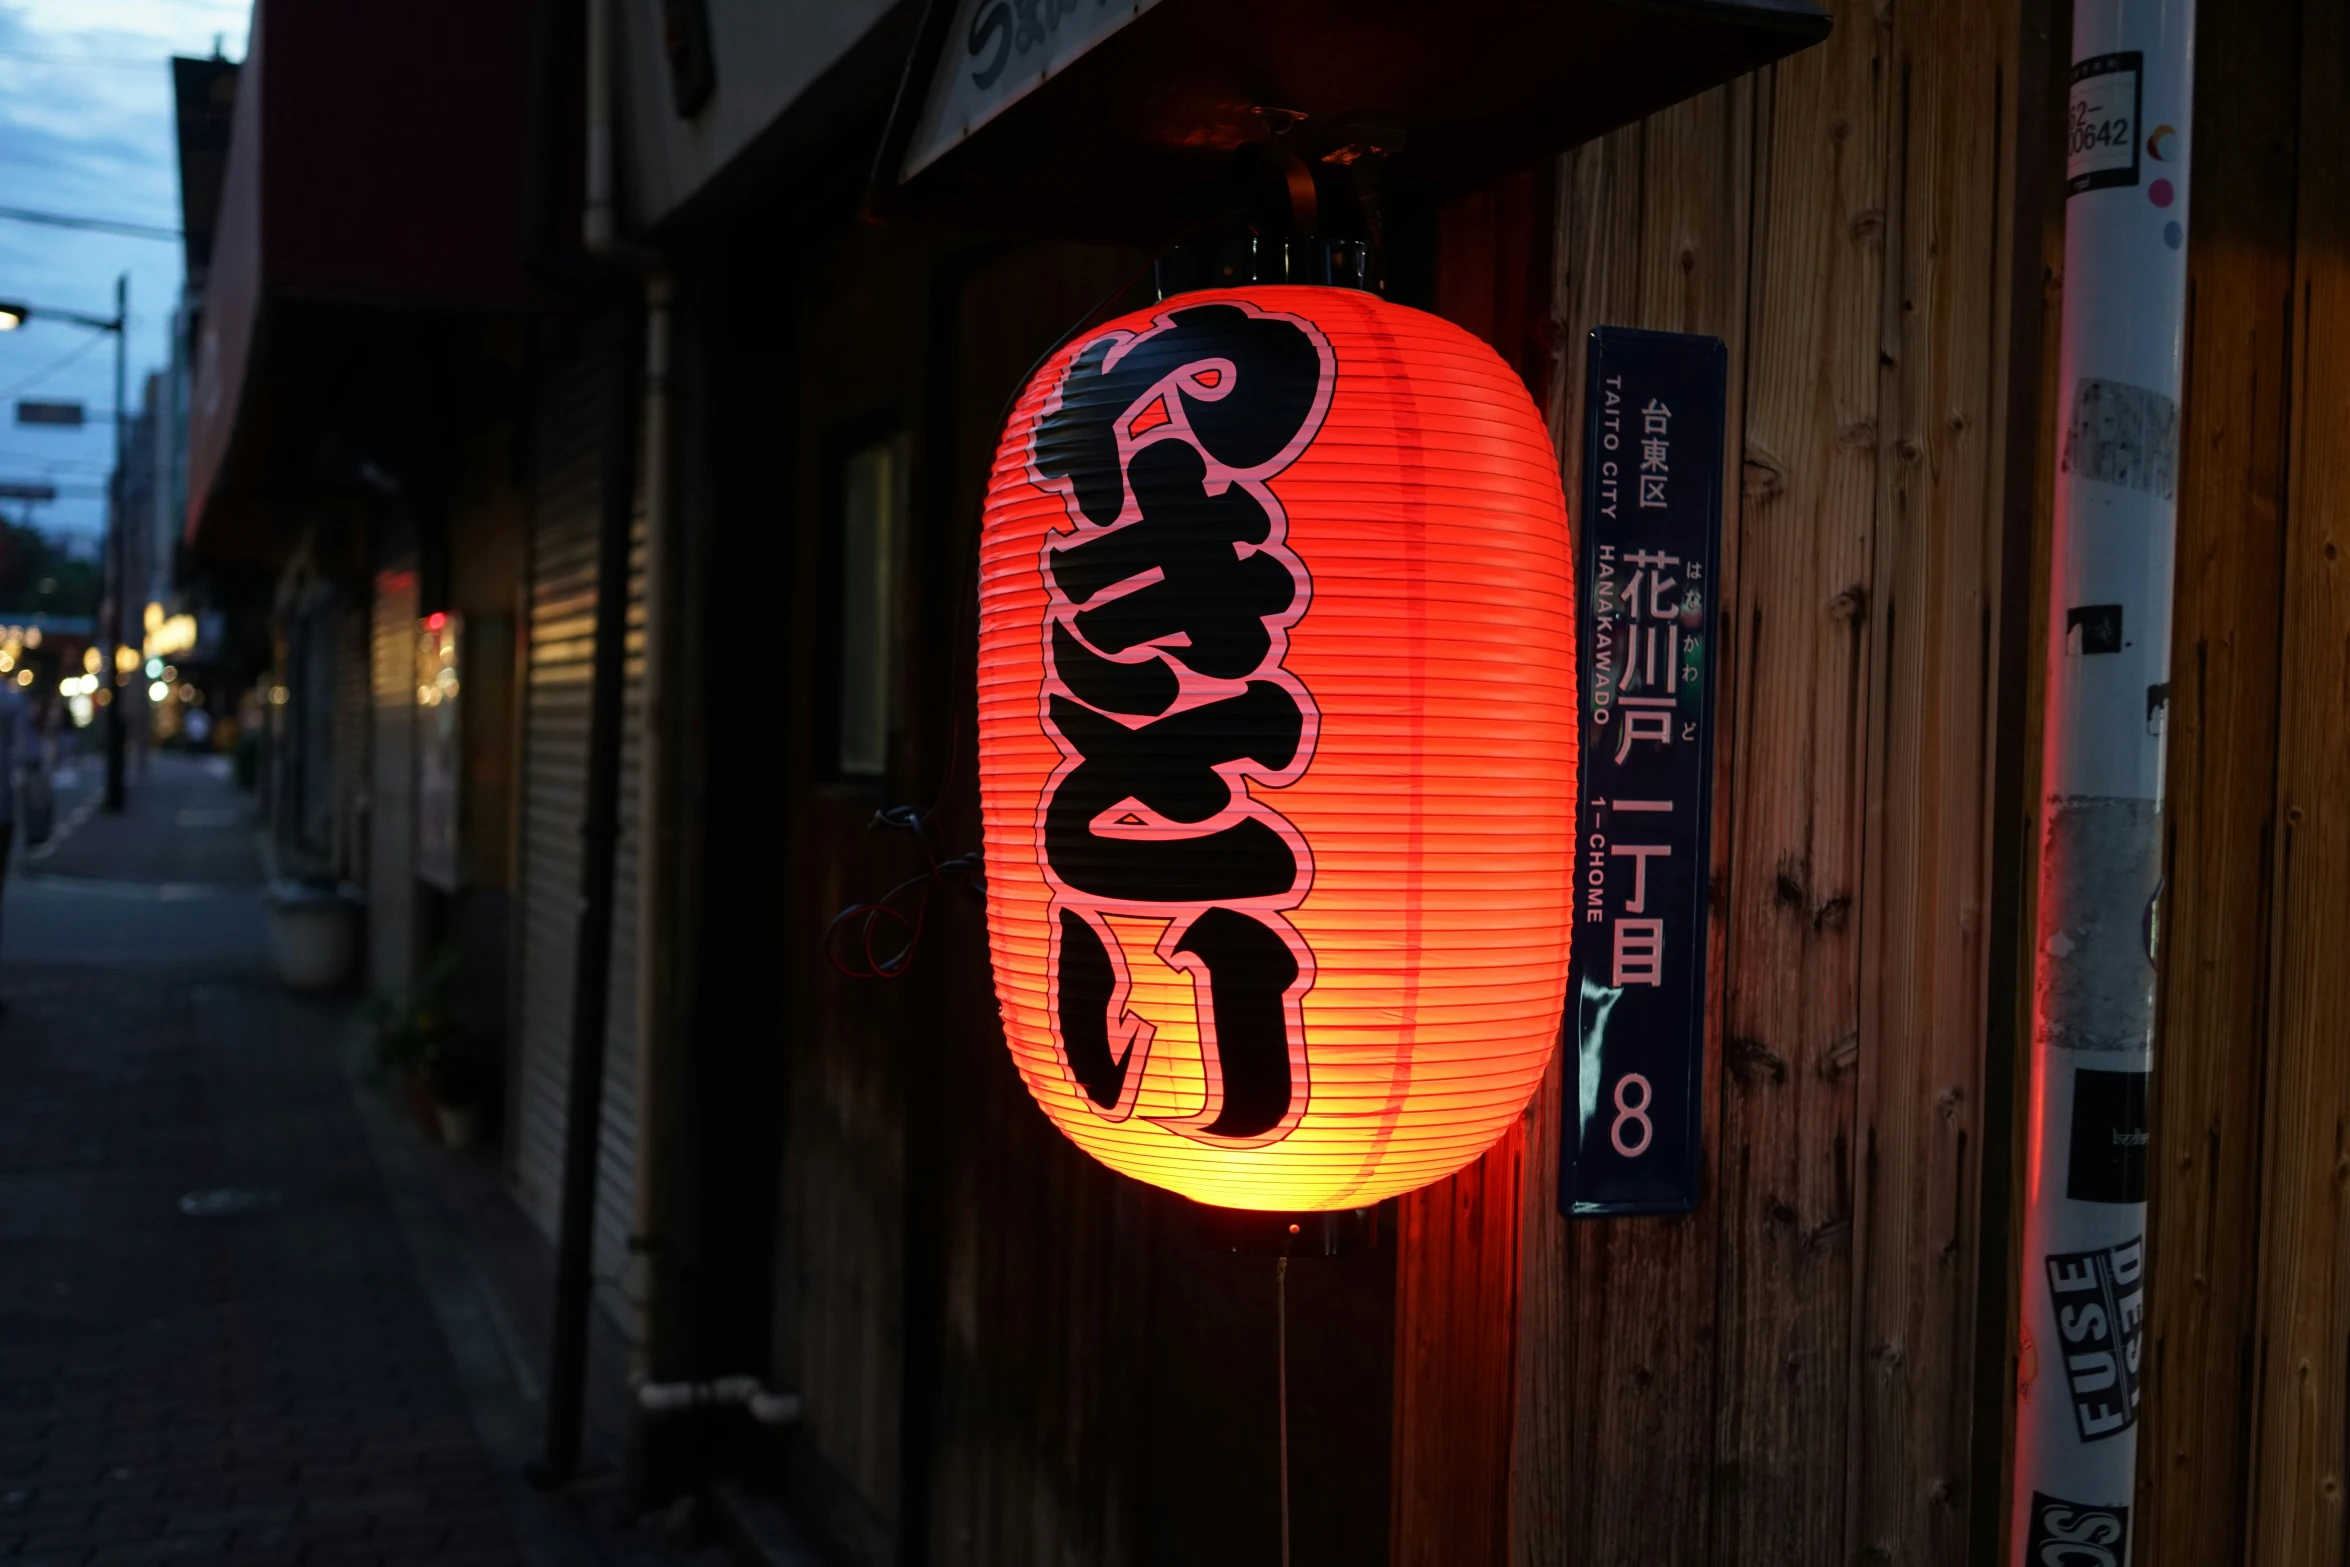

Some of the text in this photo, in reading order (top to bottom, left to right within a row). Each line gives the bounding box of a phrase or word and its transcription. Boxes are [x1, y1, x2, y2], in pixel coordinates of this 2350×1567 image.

[1639, 397, 1672, 509] 台東区
[1029, 302, 1335, 1145] やきとり
[1587, 375, 1622, 924] TAITO CITY HANAKAWADO 1-CHOME
[1611, 1073, 1653, 1158] 8
[2050, 1256, 2124, 1436] FUSE
